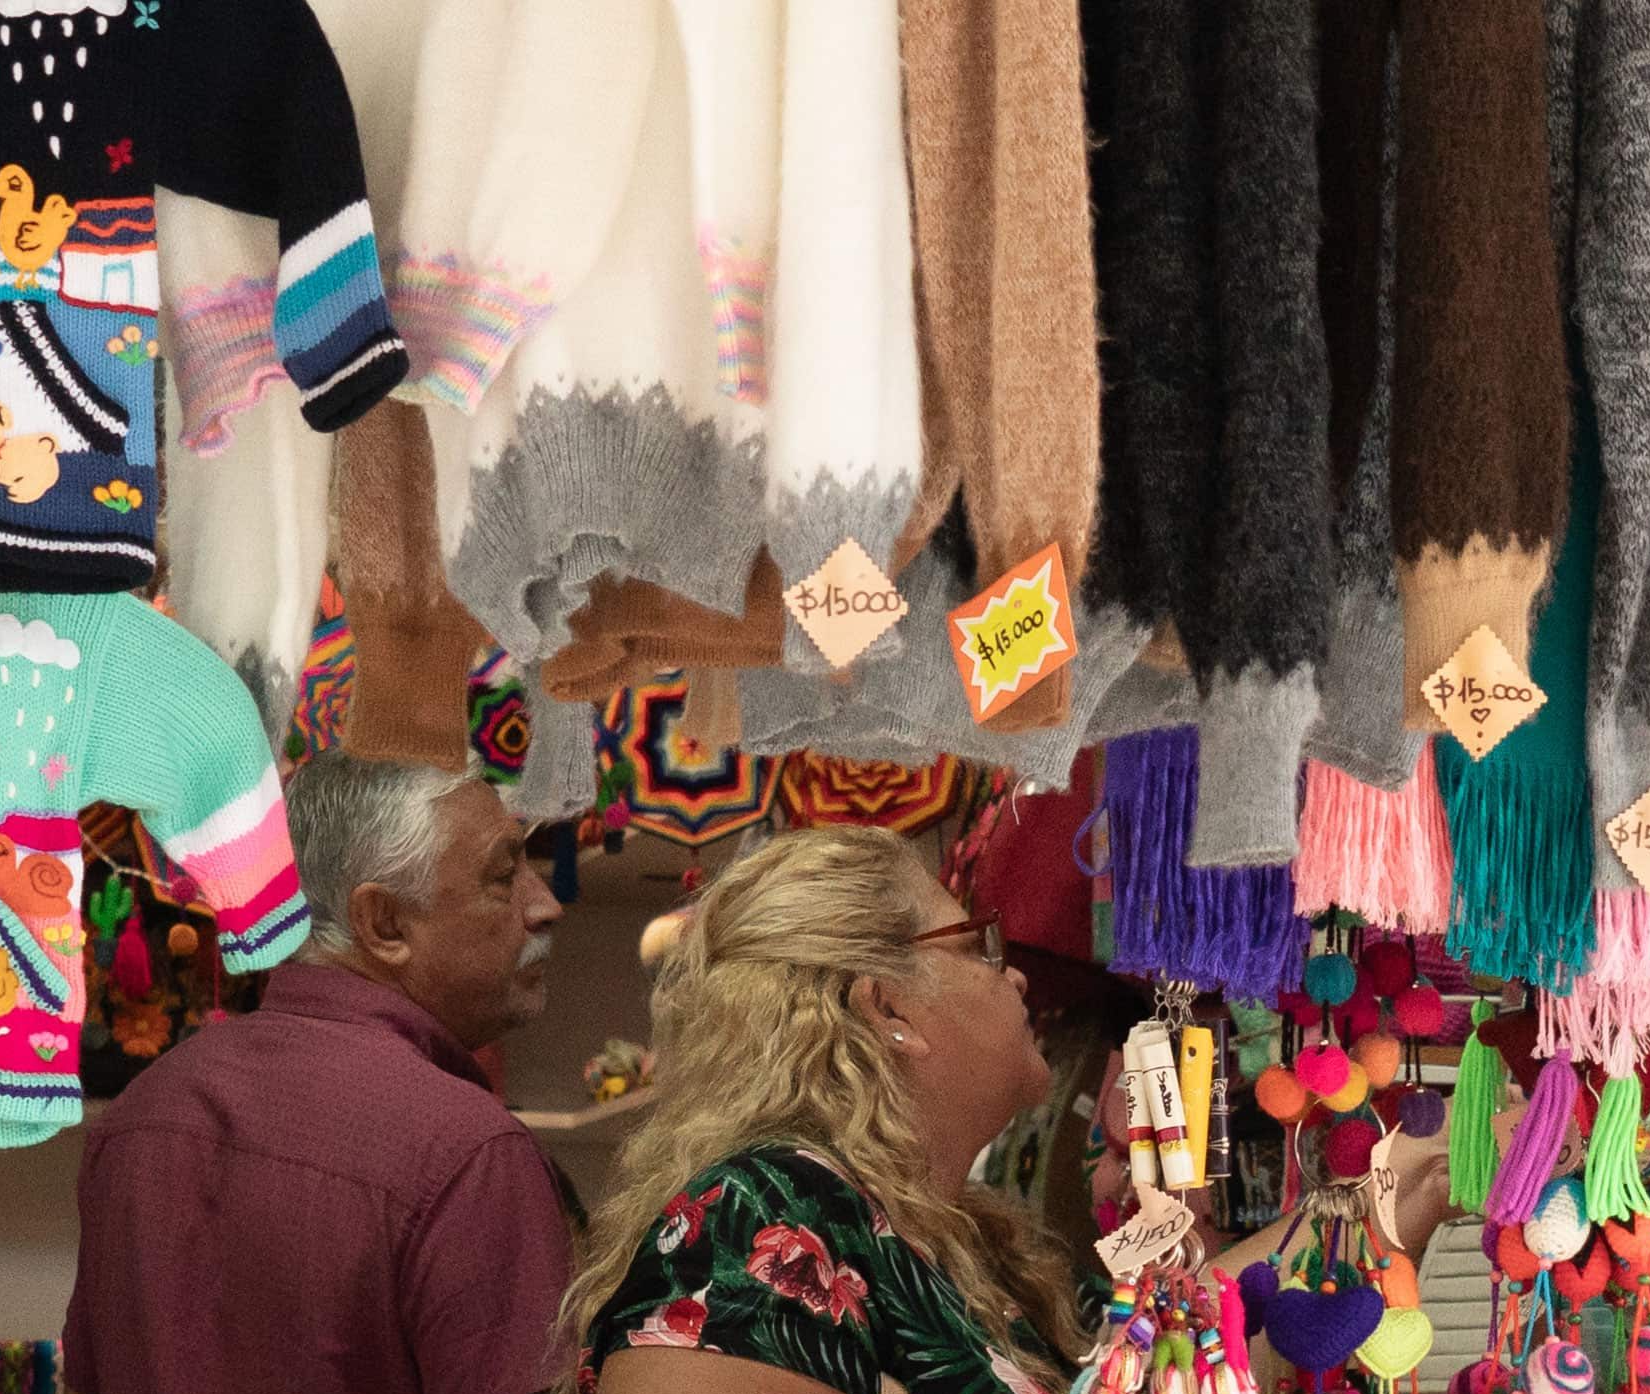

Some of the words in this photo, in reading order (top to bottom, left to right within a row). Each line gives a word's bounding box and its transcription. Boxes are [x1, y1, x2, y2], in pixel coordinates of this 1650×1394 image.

[794, 583, 902, 619] $15000
[976, 609, 1045, 671] $15.000
[1432, 675, 1533, 711] $15.000
